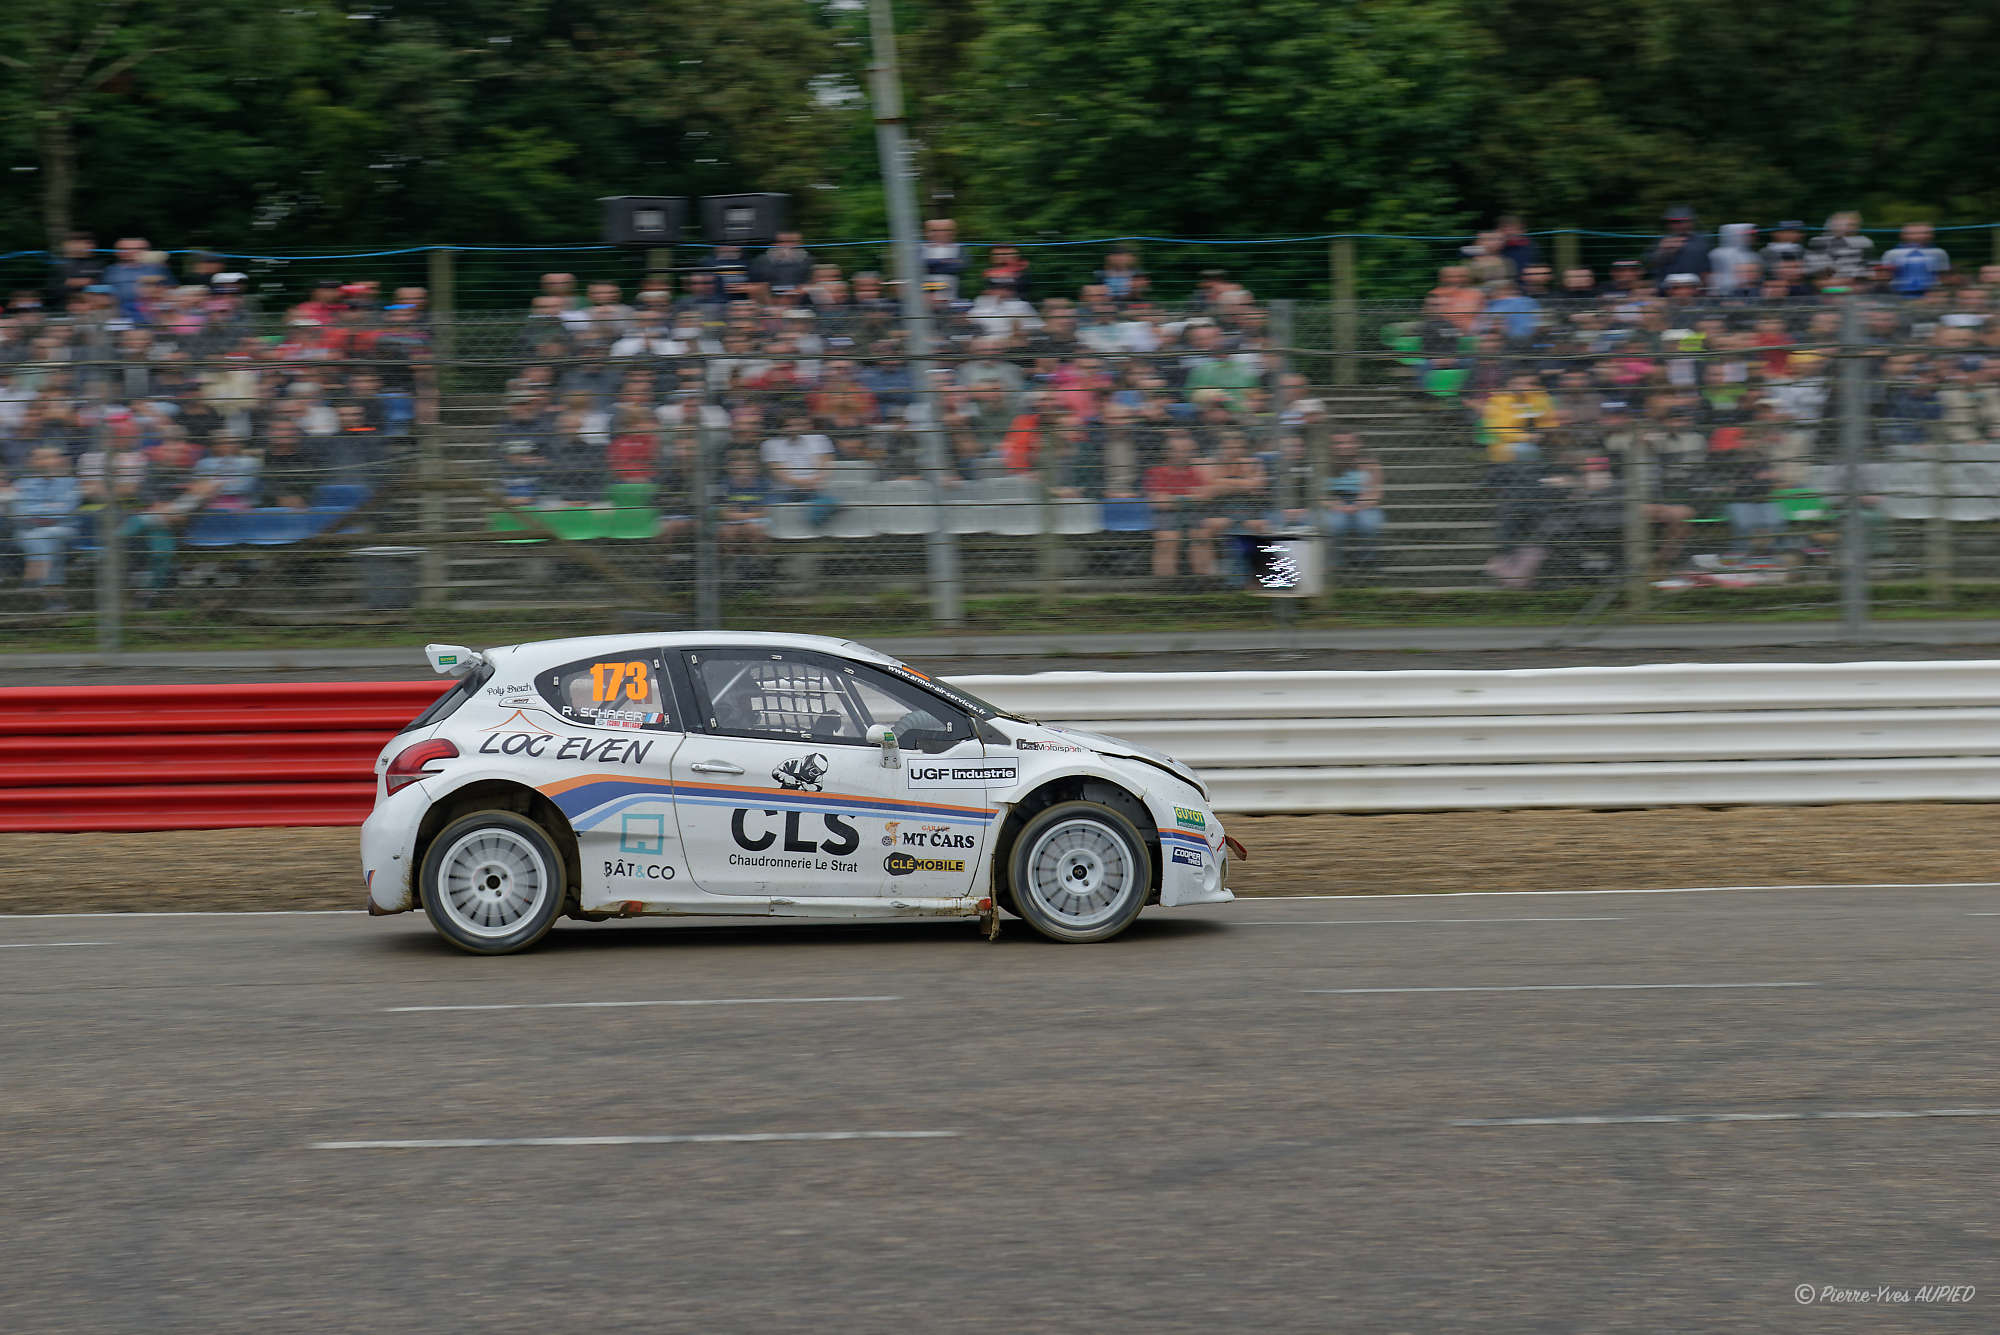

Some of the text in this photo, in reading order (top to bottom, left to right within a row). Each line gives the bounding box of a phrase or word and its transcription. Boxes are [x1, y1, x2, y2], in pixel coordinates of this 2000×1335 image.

[590, 661, 648, 702] 173
[888, 664, 987, 715] www.armor-air-services.fr
[479, 732, 655, 765] LOC EVEN
[910, 768, 1015, 780] UGF industrie
[1175, 807, 1204, 824] GUYOT
[731, 808, 860, 856] CLS
[903, 832, 975, 849] MT CARS
[729, 854, 858, 873] Chaudronnerie Le Strat
[891, 857, 964, 871] CLÉMOBILE
[1174, 849, 1201, 861] COOPER
[604, 859, 675, 880] BÂT&CO
